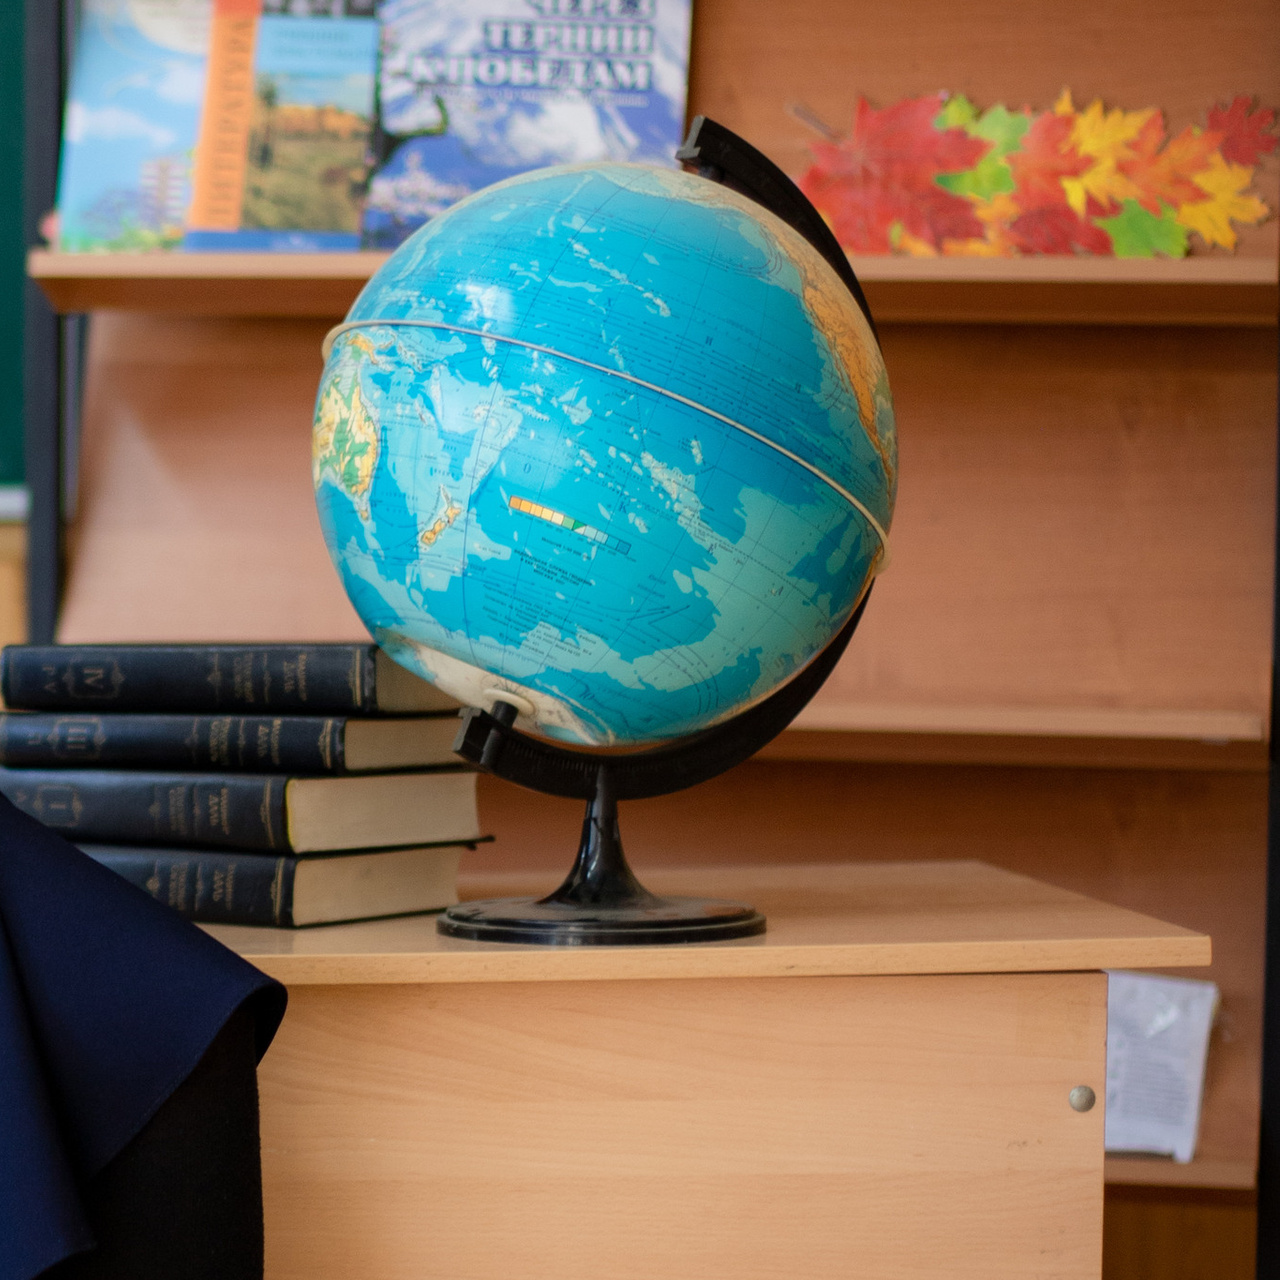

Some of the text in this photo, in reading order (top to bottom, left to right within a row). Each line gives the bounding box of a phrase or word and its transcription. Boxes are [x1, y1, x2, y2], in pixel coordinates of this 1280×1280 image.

[483, 21, 654, 53] ТЕРНИИ
[83, 667, 104, 690] IV
[67, 728, 87, 749] III
[258, 725, 270, 757] ДАЛЬ
[212, 869, 224, 902] ДАЛЬ
